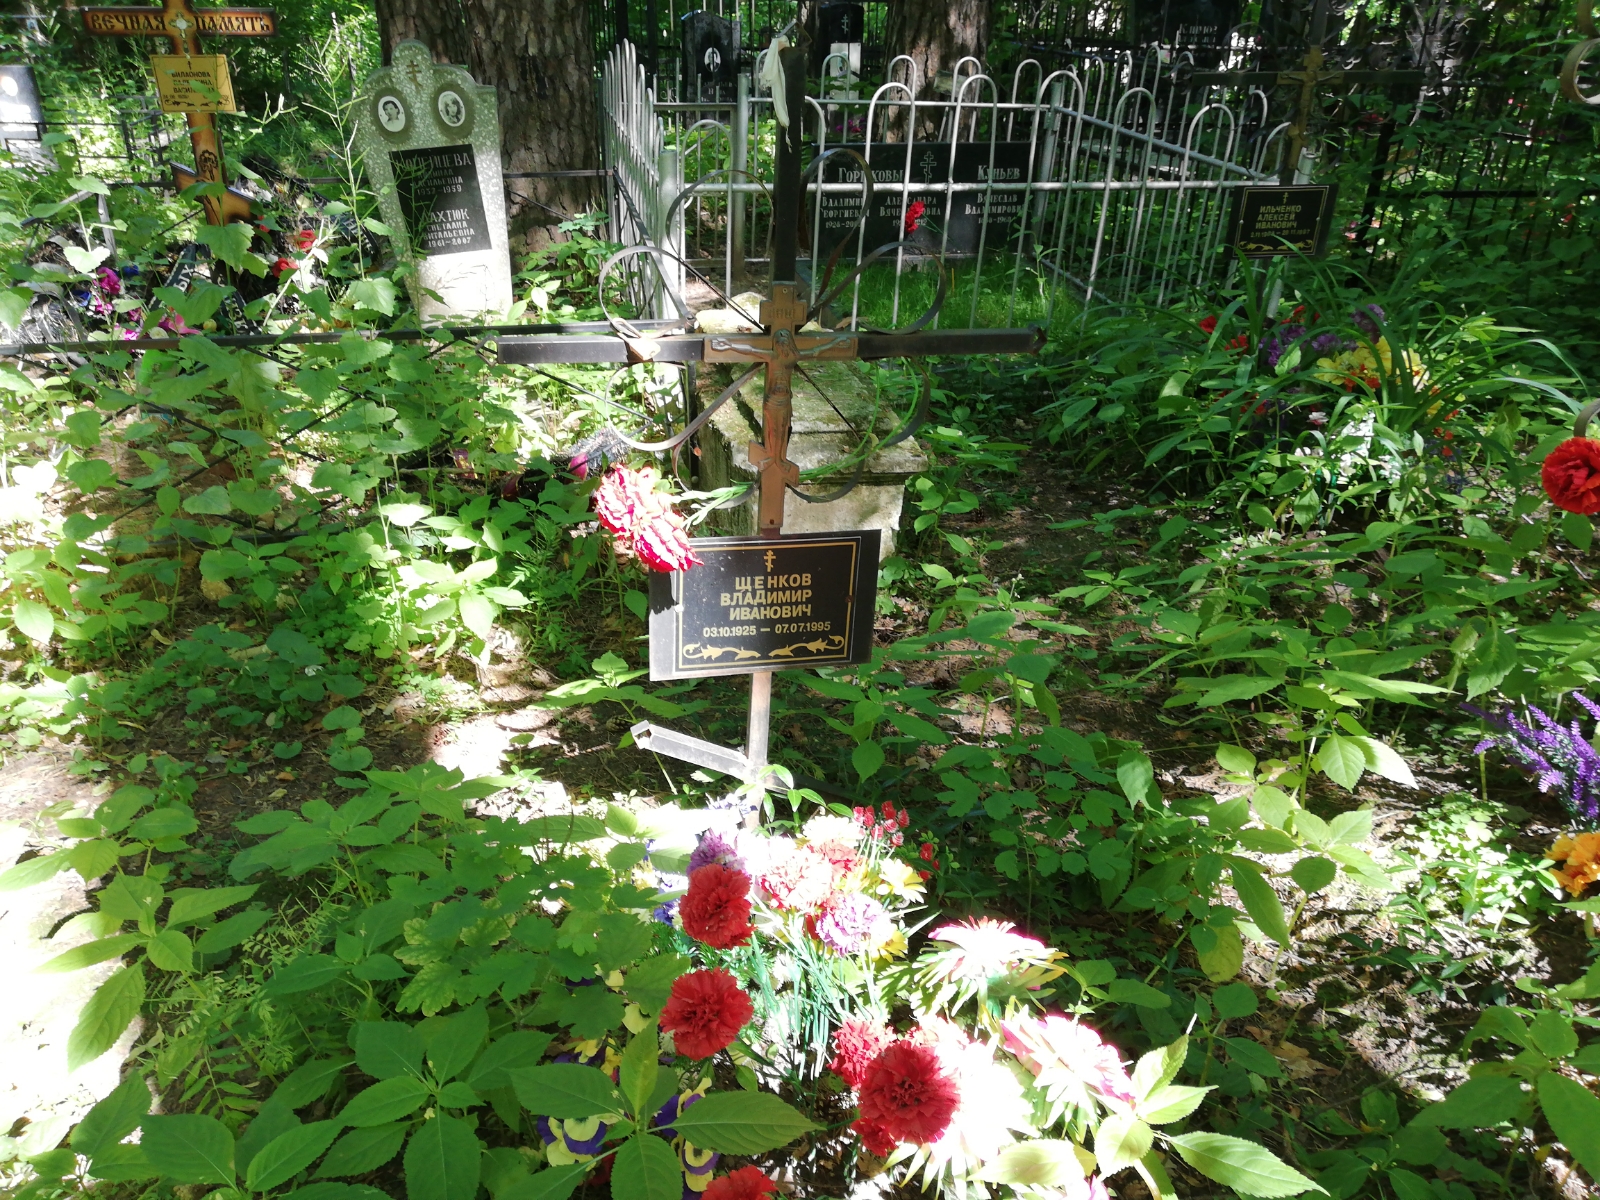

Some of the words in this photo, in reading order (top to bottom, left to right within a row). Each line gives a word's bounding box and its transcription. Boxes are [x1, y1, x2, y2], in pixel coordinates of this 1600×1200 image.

[91, 14, 167, 31] ВЕЧНАЯ
[193, 14, 270, 32] ПАМЯТЬ
[838, 167, 904, 183] ГОРКОВЫ
[822, 196, 866, 207] ВЛАДИМИ
[885, 196, 937, 206] АЛЕСАНДРА
[421, 208, 470, 223] АХТЮК
[820, 208, 870, 218] ЕОРГИЕВЧ
[1257, 212, 1296, 221] АЛЕКСЕЙ
[1259, 205, 1302, 213] ИЛЬЧЕНКО
[1255, 221, 1297, 229] ИВАНОВИЧ
[735, 573, 812, 592] ЩЕНКОВ
[720, 589, 813, 607] ВЛАДИМИР
[729, 604, 812, 621] ИВАНОВИЧ
[703, 625, 757, 638] 03.10.1925
[775, 621, 831, 634] 07.07.1995
